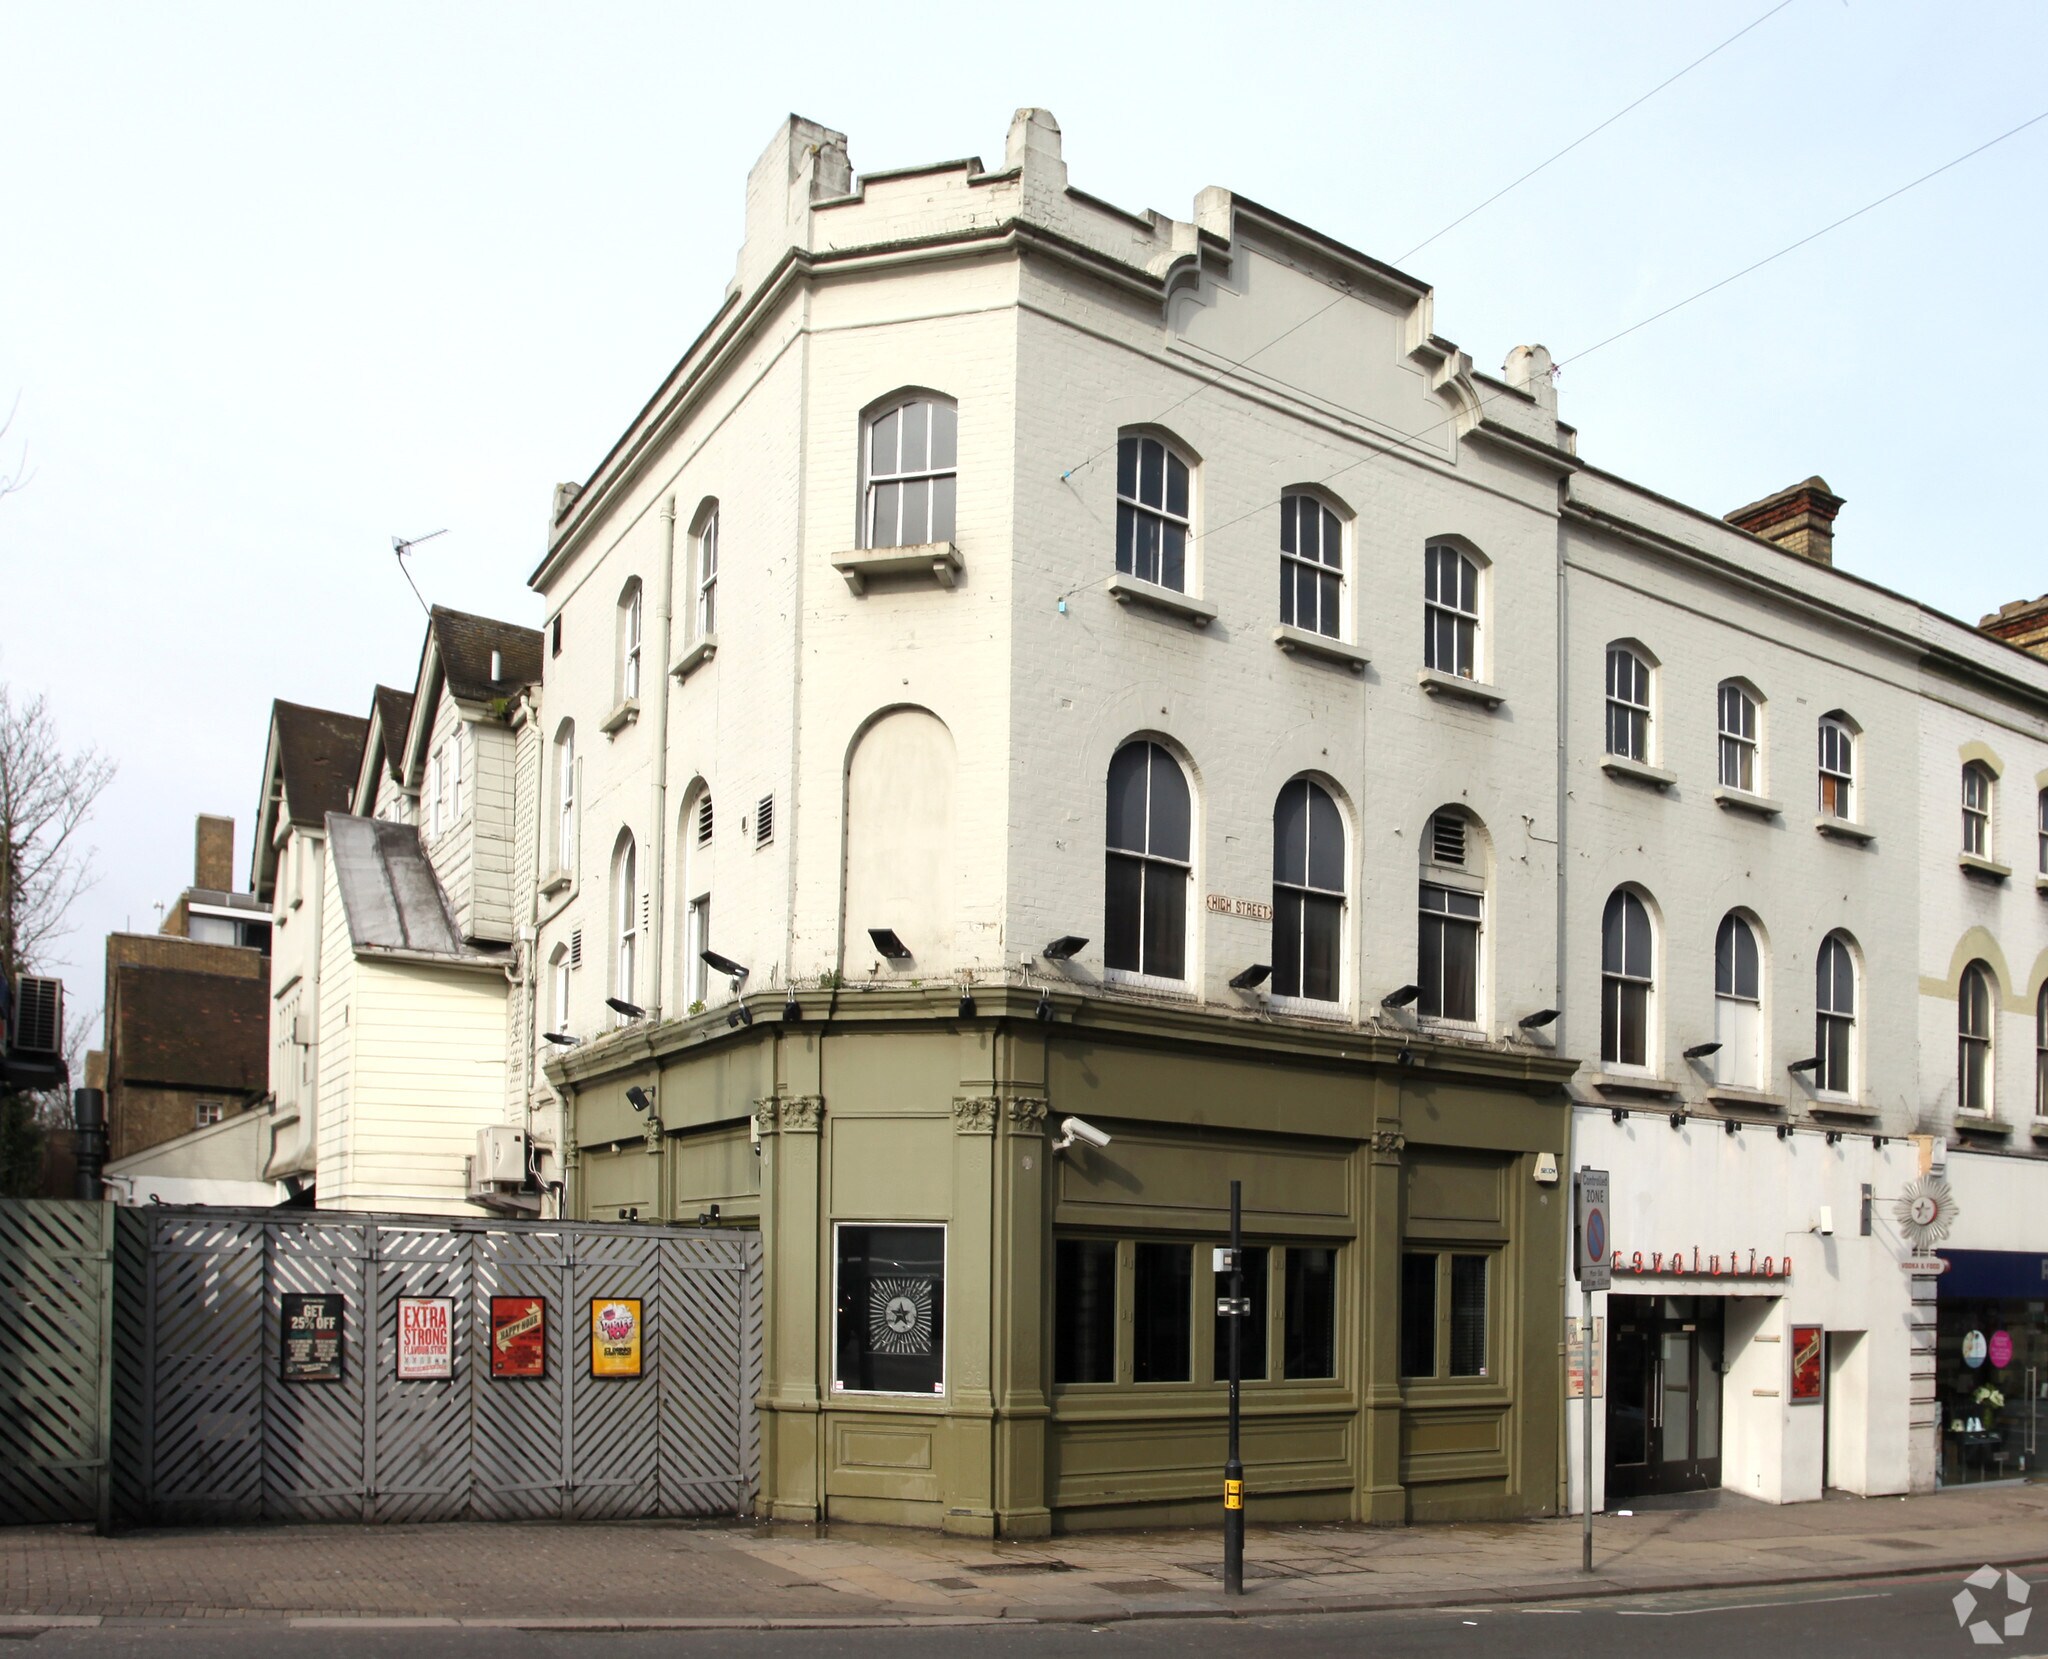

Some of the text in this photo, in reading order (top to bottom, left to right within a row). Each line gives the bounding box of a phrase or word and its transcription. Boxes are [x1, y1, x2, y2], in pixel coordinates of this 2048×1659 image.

[1212, 896, 1267, 918] HIGH STREET
[1583, 1174, 1608, 1186] Controlled
[1586, 1189, 1604, 1203] ZONE
[1926, 1262, 1940, 1270] FOOD
[303, 1304, 324, 1317] GET
[404, 1306, 447, 1328] EXTRA
[291, 1316, 336, 1330] 25% OFF
[500, 1324, 520, 1340] HAPPY
[521, 1314, 538, 1330] HOUR
[404, 1328, 447, 1346] STRONG
[607, 1326, 629, 1340] POP
[430, 1346, 447, 1355] STICK
